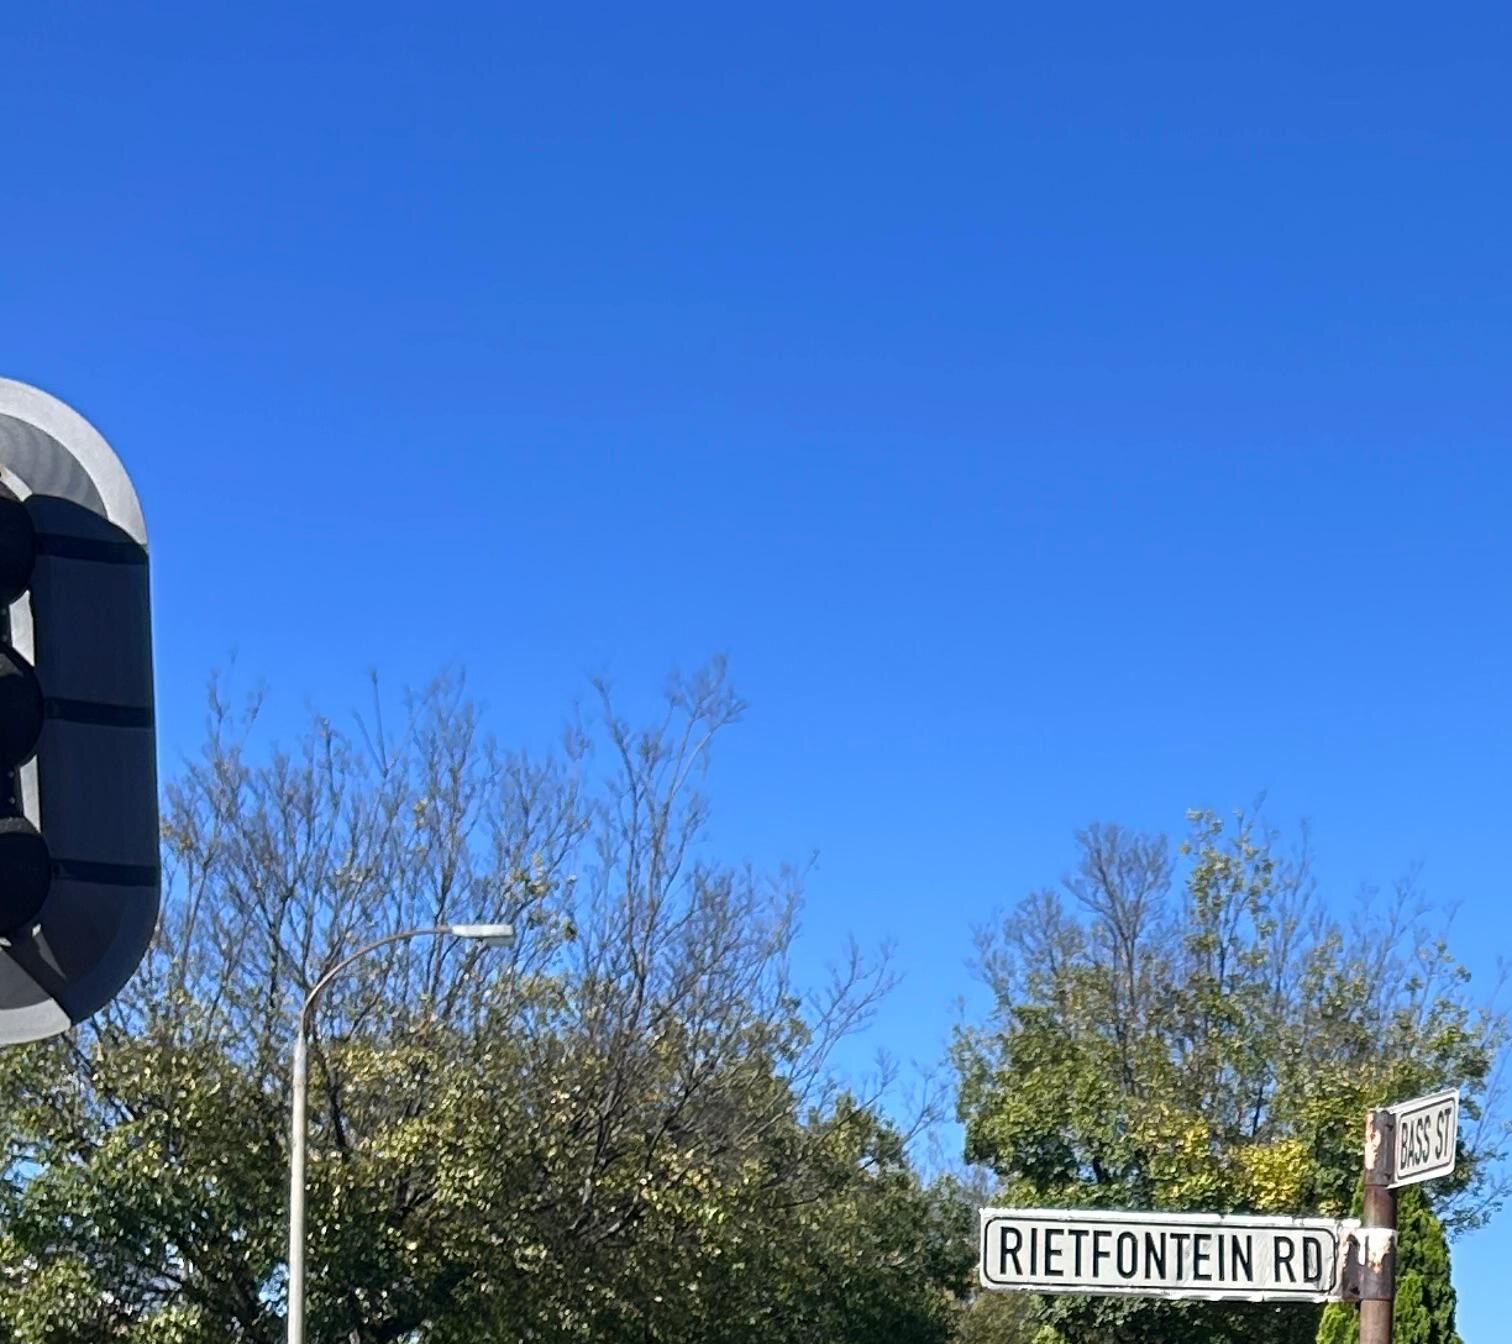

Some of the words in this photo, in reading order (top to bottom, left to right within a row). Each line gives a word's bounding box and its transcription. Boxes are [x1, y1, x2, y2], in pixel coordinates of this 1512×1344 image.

[1400, 1114, 1431, 1170] BASS
[1435, 1107, 1452, 1160] ST
[1000, 1226, 1254, 1282] RIETFONTEIN
[1274, 1236, 1323, 1283] RD
